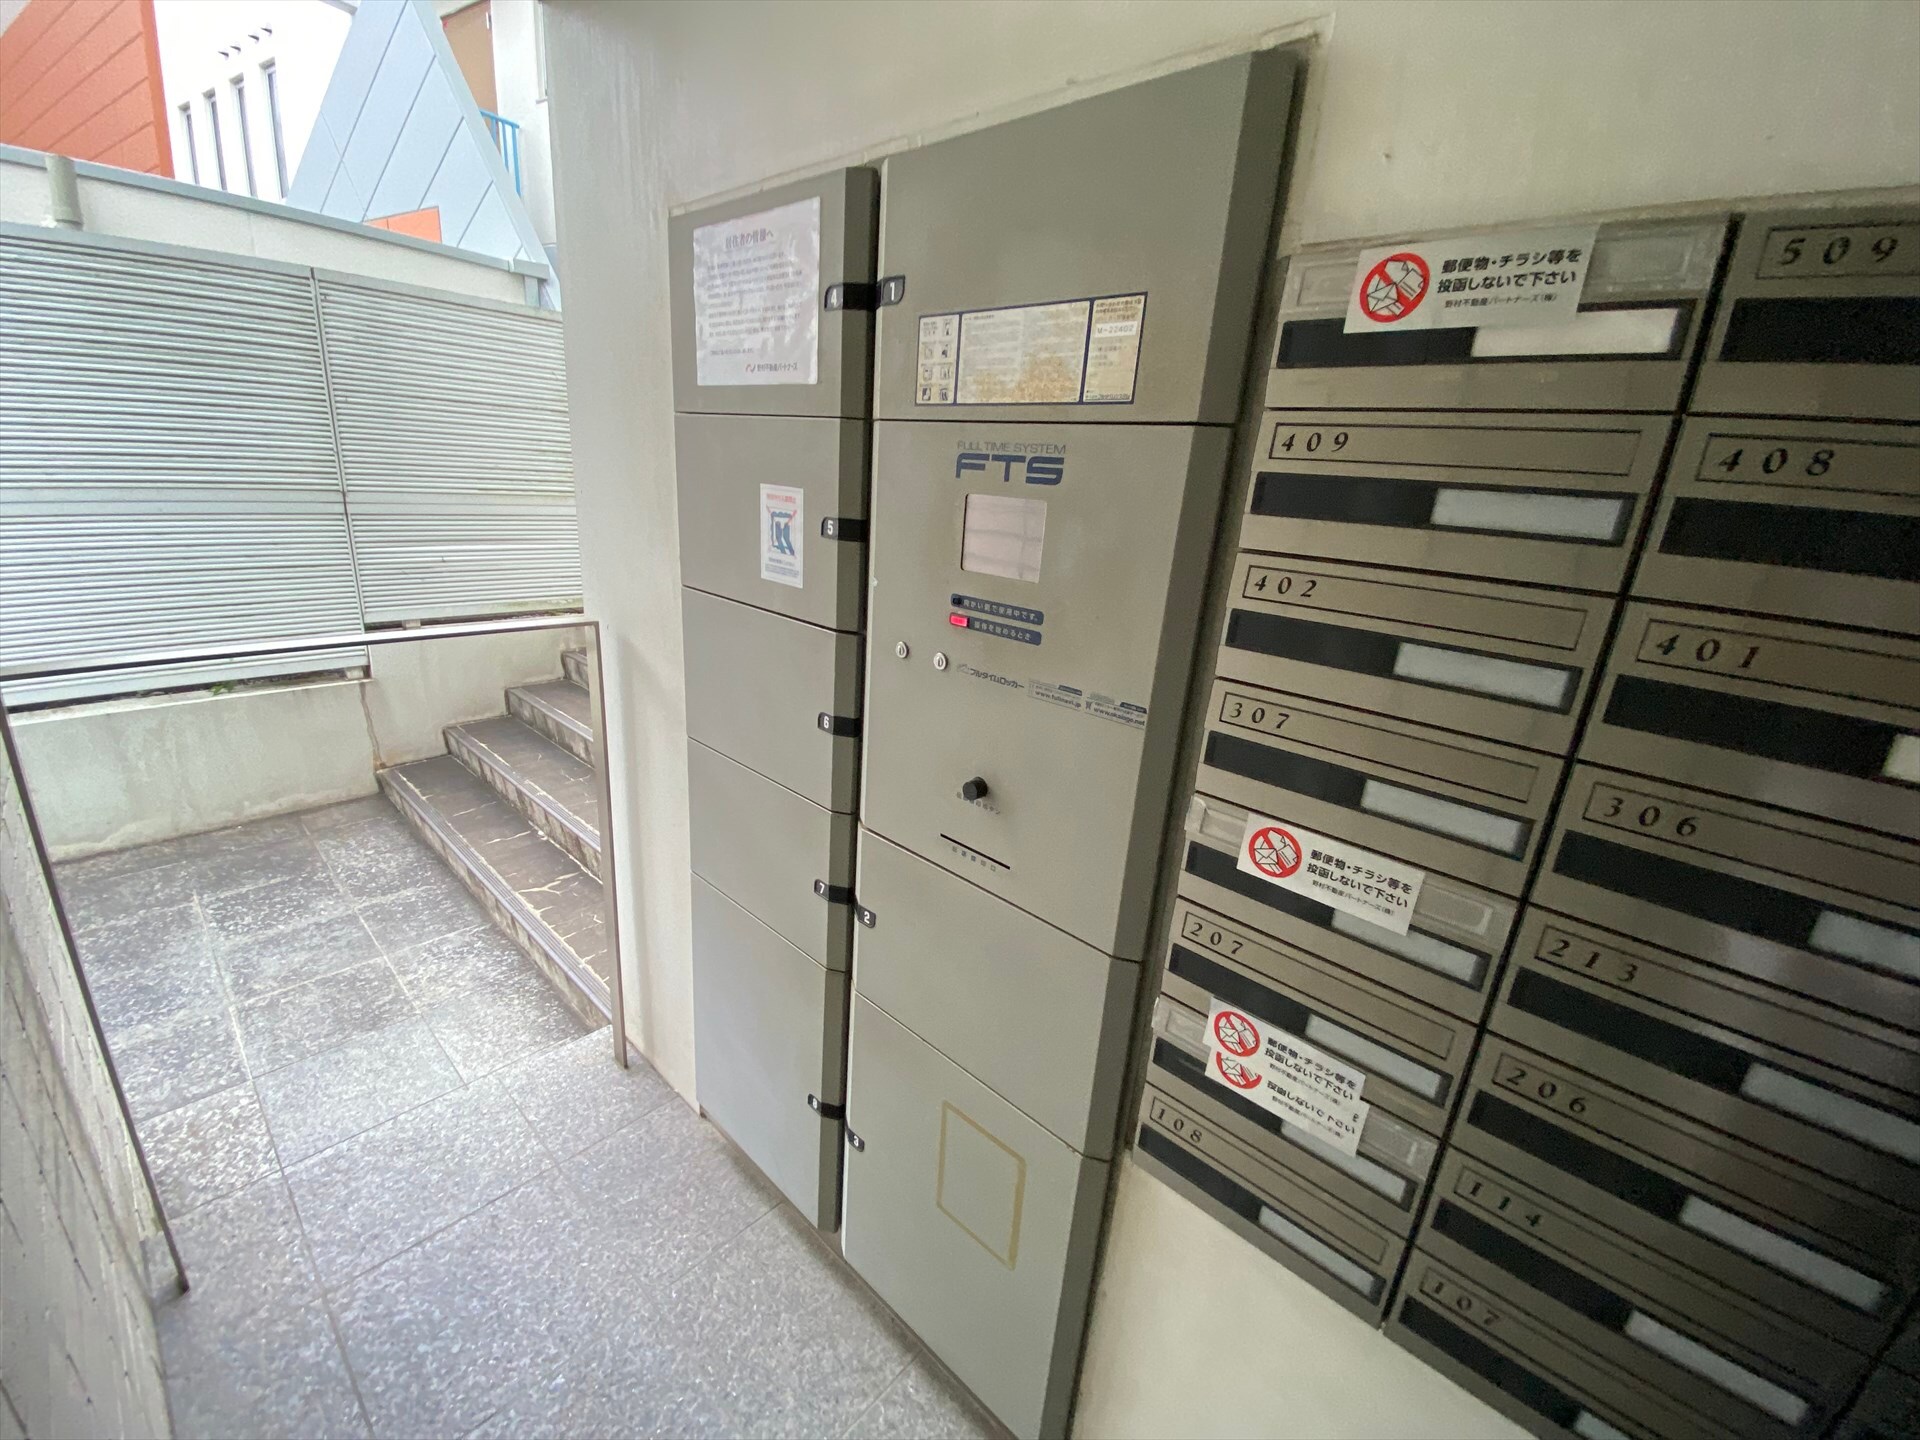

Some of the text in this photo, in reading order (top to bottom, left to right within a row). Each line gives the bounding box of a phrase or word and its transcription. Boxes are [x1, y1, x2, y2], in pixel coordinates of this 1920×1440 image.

[1441, 248, 1583, 274] 郵便物・チラシ等を
[1780, 236, 1898, 266] 509
[889, 281, 896, 301] 1
[1436, 270, 1577, 294] 投函しないで下さい
[831, 288, 837, 309] 4
[957, 441, 1066, 454] FULL TIME SYSTEM
[1281, 431, 1349, 453] 409
[955, 452, 1065, 486] FTS
[1718, 447, 1835, 477] 408
[827, 520, 834, 536] 5
[1253, 574, 1318, 599] 402
[1655, 632, 1761, 669] 401
[969, 668, 1025, 689] フルタイムロッカー
[823, 715, 829, 729] 6
[1229, 702, 1290, 730] 307
[1604, 796, 1700, 838] 306
[1307, 863, 1408, 908] 投函しないで下さい
[1310, 849, 1413, 895] 郵便物・チラシ等を
[820, 882, 825, 894] 7
[864, 910, 870, 924] 2
[1190, 922, 1243, 955] 207
[1547, 938, 1639, 984] 213
[1264, 1047, 1353, 1101] 投函しないで下さい
[1267, 1037, 1356, 1090] 郵便物・チラシ等を
[1506, 1067, 1586, 1114] 206
[853, 1135, 859, 1147] 3
[1157, 1108, 1202, 1144] 108
[1469, 1181, 1542, 1227] 114
[1434, 1281, 1500, 1326] 107
